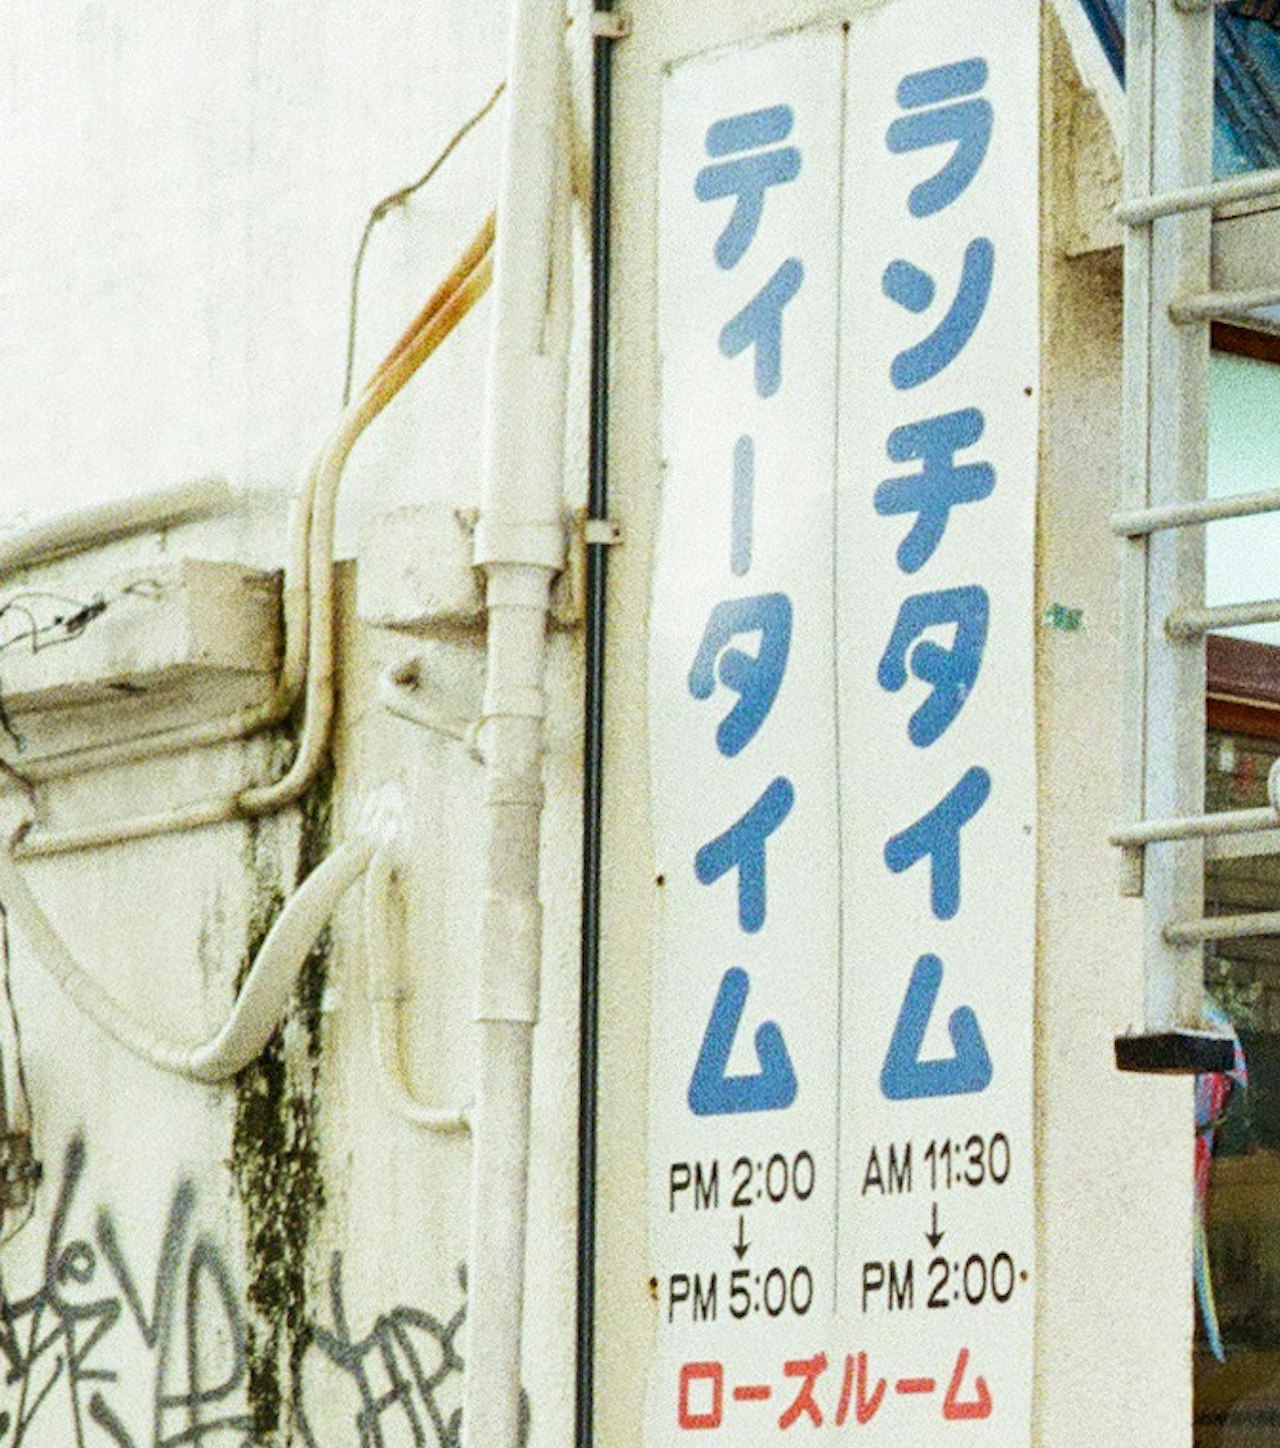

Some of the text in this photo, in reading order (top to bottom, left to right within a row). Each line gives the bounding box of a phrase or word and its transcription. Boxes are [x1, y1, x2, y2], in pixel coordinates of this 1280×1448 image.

[686, 102, 805, 1118] ティータイム
[873, 56, 997, 1102] ランチタイム
[669, 1149, 815, 1213] PM 2:00
[861, 1131, 1011, 1197] AM 11:30
[668, 1264, 814, 1323] PM 5:00
[862, 1251, 1015, 1313] PM 2:00
[677, 1347, 993, 1431] ローズルーム
